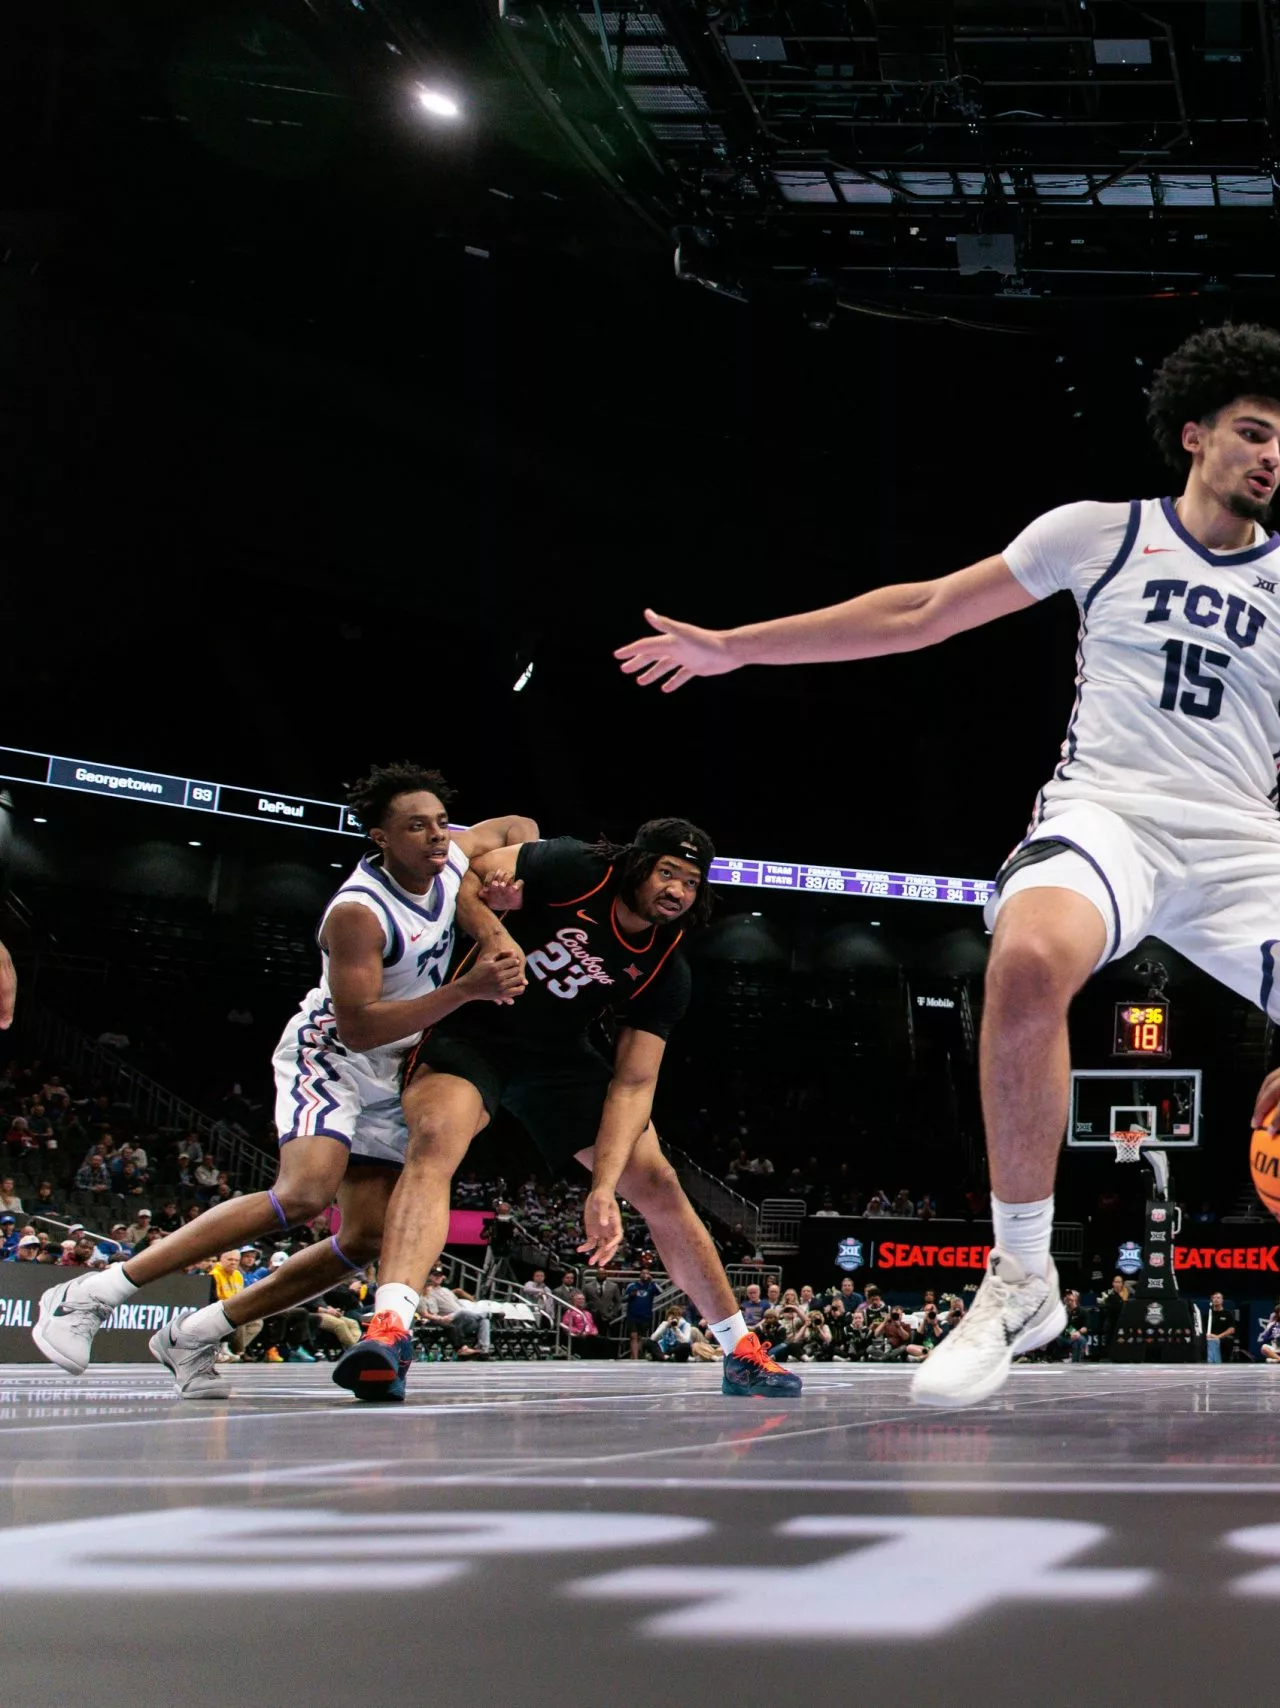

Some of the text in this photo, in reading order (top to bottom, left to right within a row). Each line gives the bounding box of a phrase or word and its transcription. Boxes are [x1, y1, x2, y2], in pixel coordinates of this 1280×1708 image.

[1142, 579, 1267, 649] TCU
[1160, 638, 1231, 721] 15
[76, 768, 162, 794] Georgetown
[193, 787, 213, 802] 63
[258, 799, 304, 818] DePaul
[555, 927, 615, 986] Cowboys
[526, 942, 593, 999] 23
[1134, 1024, 1158, 1050] 18
[1173, 1246, 1280, 1272] EATGEEK
